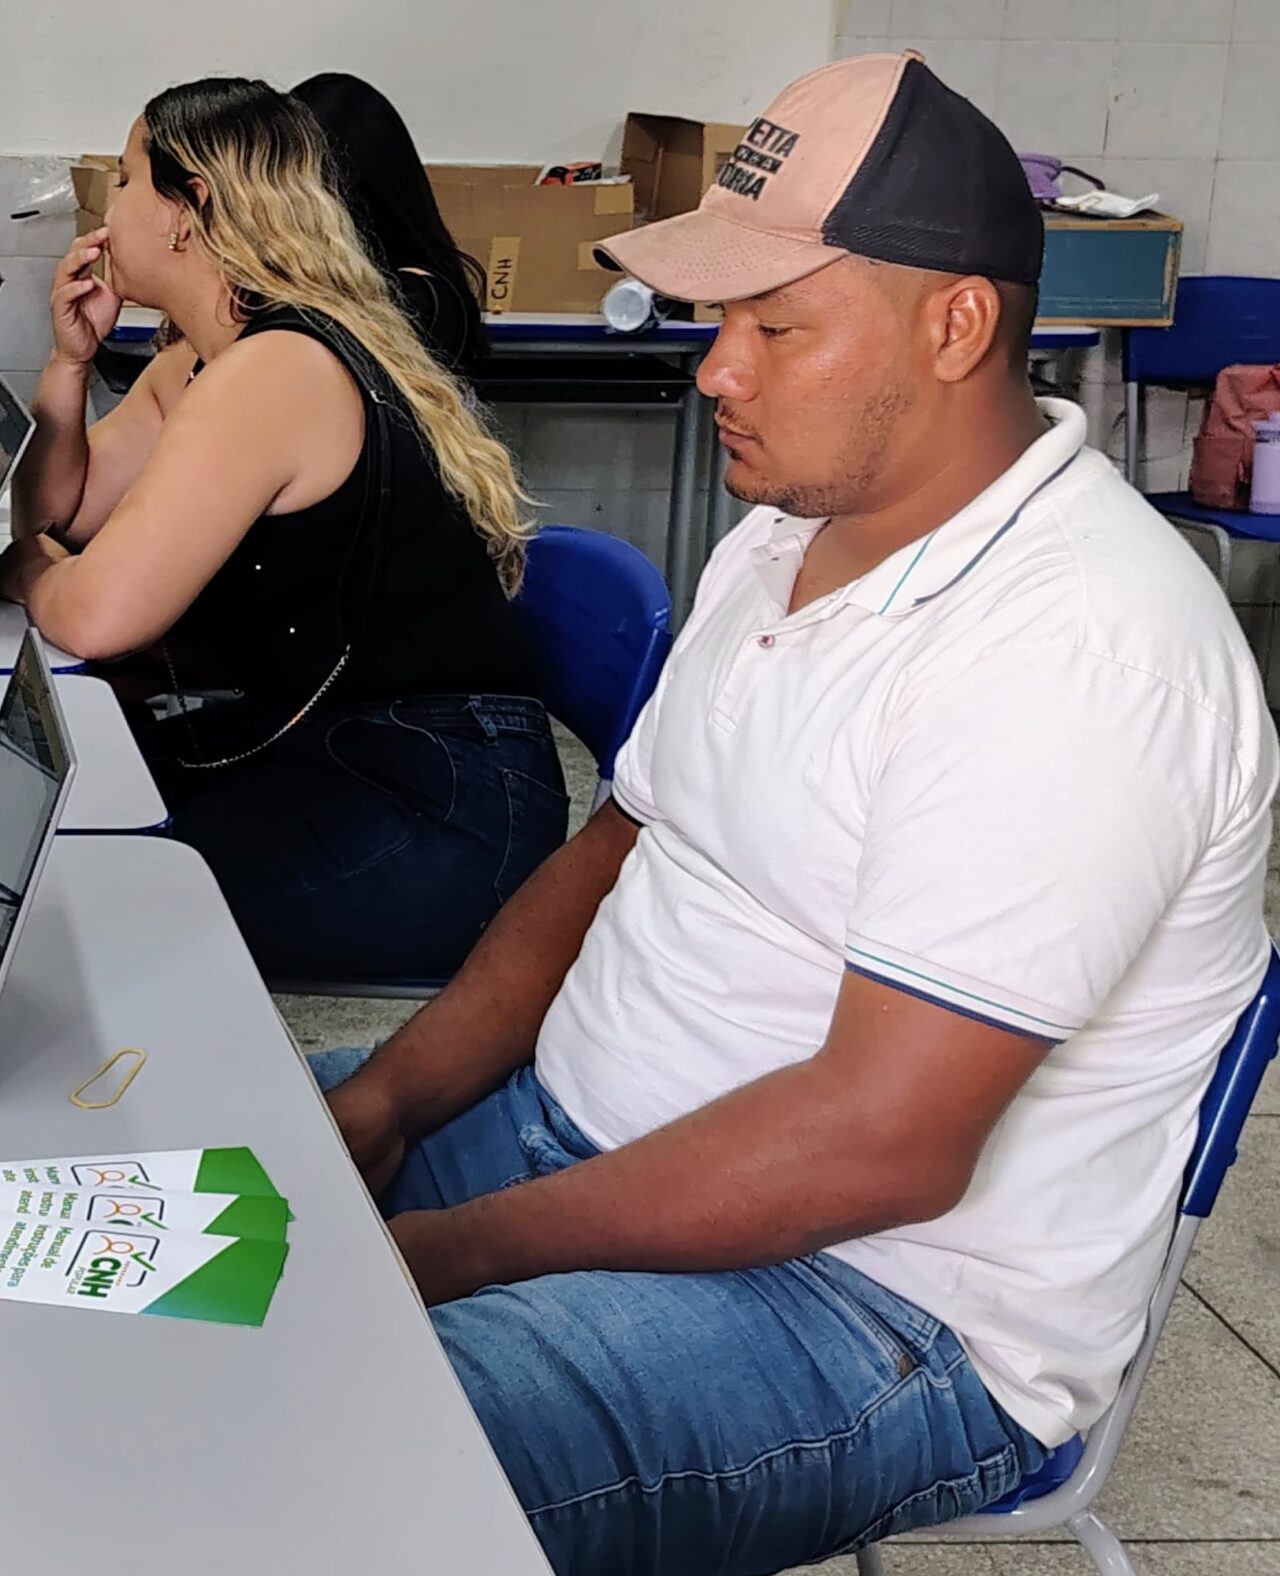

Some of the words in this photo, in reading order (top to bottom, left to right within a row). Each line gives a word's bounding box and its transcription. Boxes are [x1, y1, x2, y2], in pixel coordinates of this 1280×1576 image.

[491, 258, 513, 300] CNH
[17, 1224, 52, 1267] instruções
[46, 1226, 74, 1257] Manual
[7, 1267, 26, 1287] para
[40, 1257, 58, 1269] de
[77, 1256, 122, 1298] CNH
[66, 1266, 87, 1295] POPULAR
